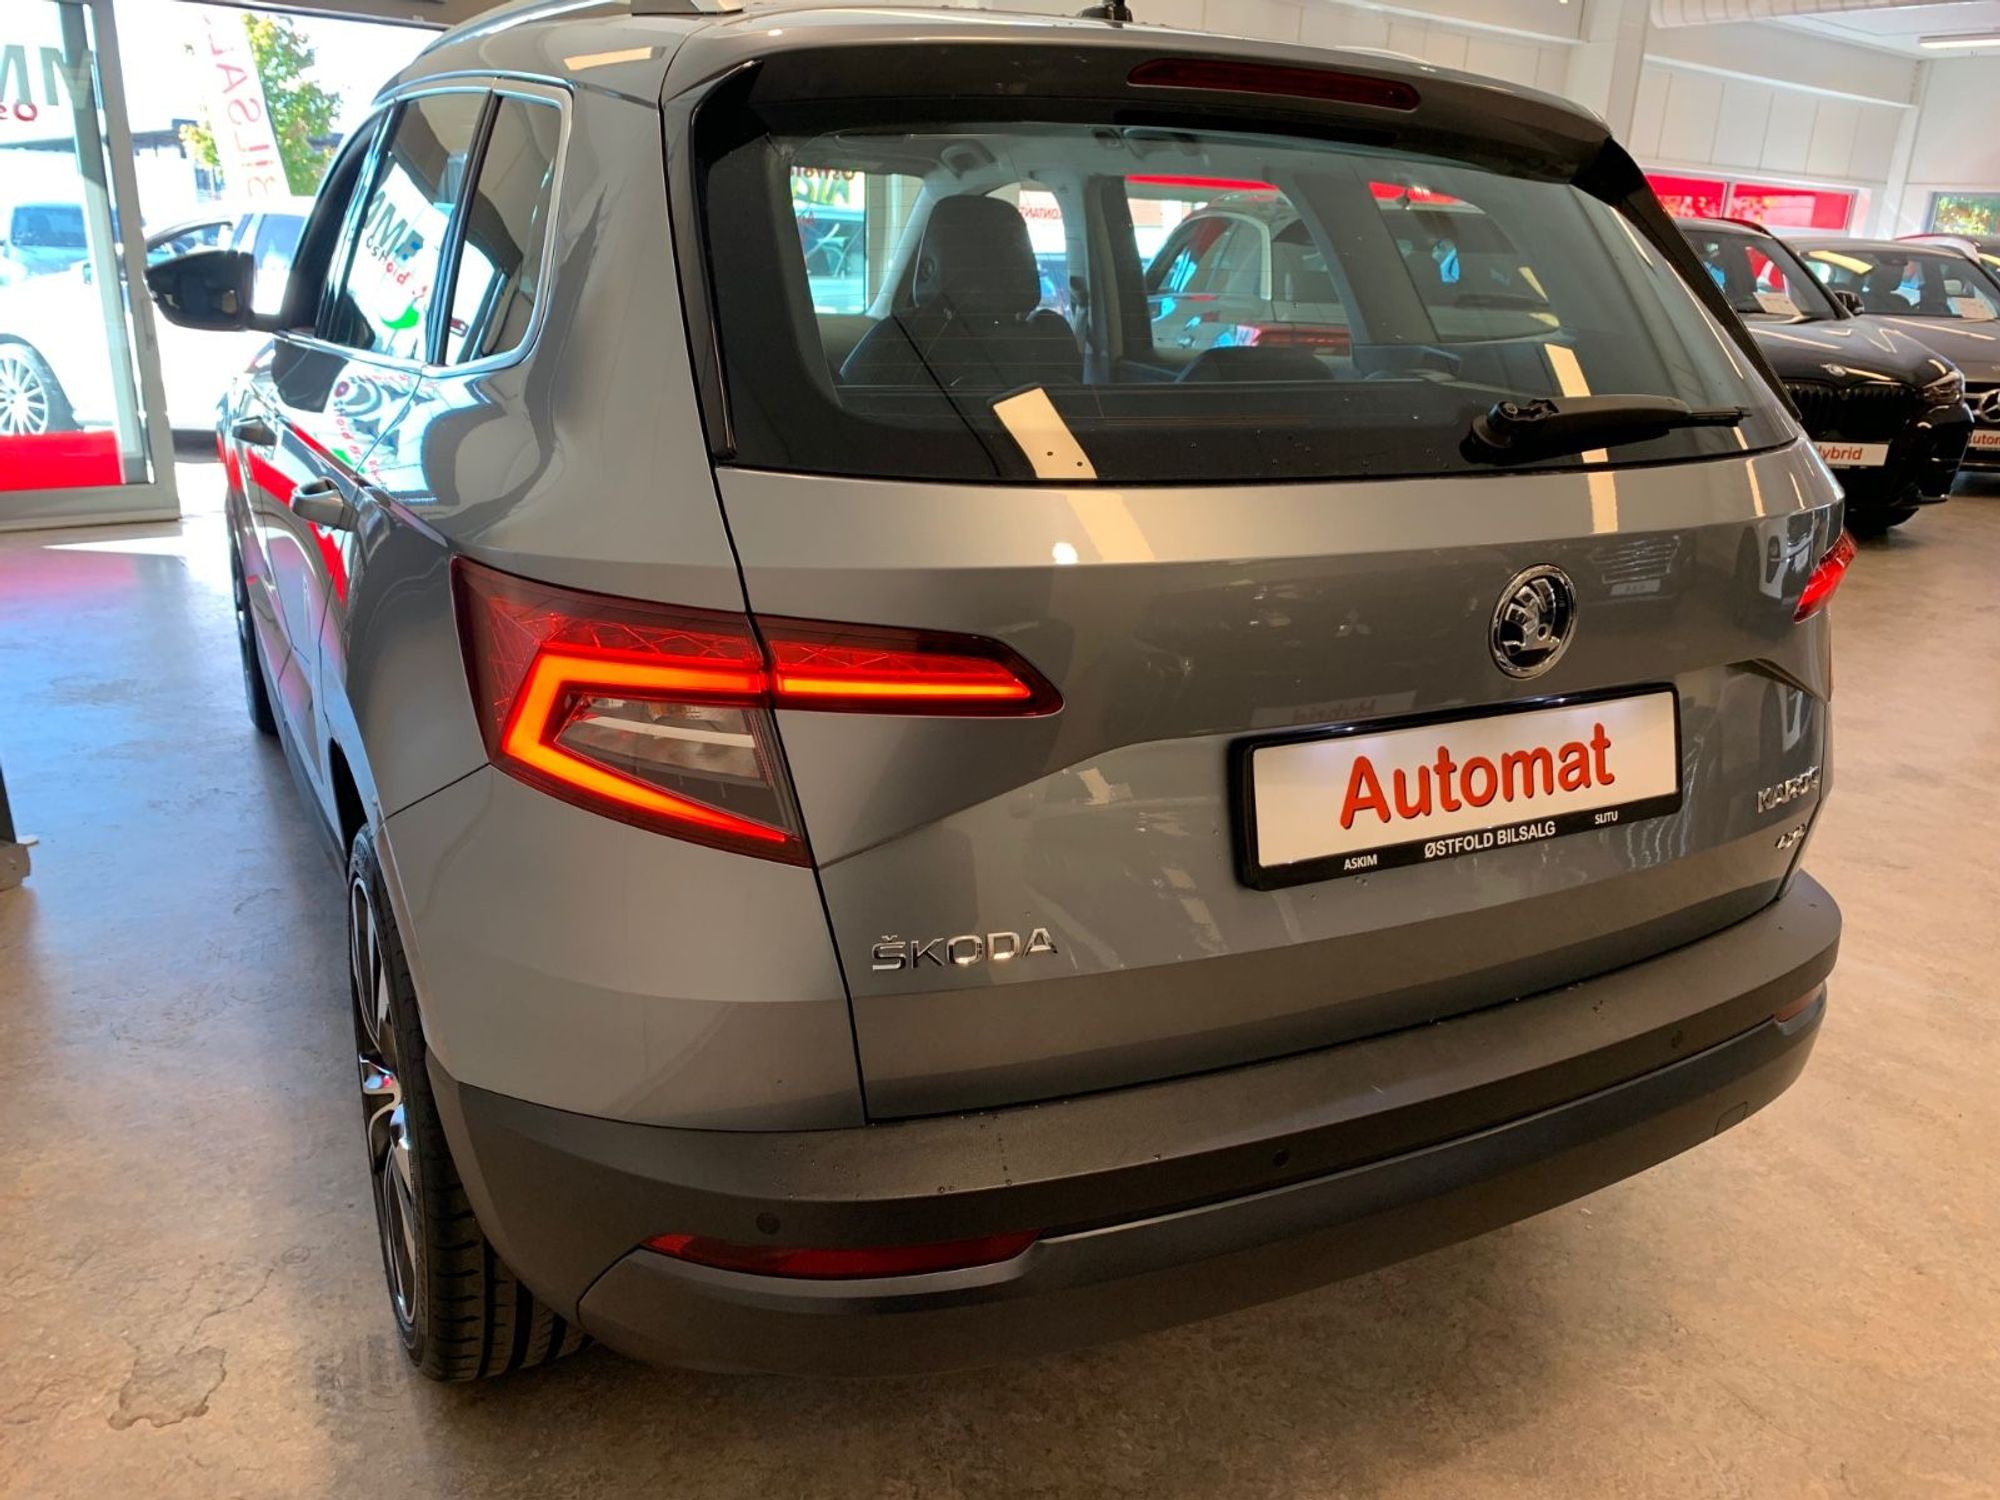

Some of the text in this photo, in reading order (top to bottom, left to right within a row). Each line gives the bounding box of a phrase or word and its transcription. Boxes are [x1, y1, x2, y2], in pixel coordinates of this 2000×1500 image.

[1339, 722, 1616, 830] Automat
[1423, 820, 1557, 860] ØSTFOLD BILSALG
[1343, 853, 1379, 871] ASKIM
[871, 927, 1059, 972] ŠKODA
